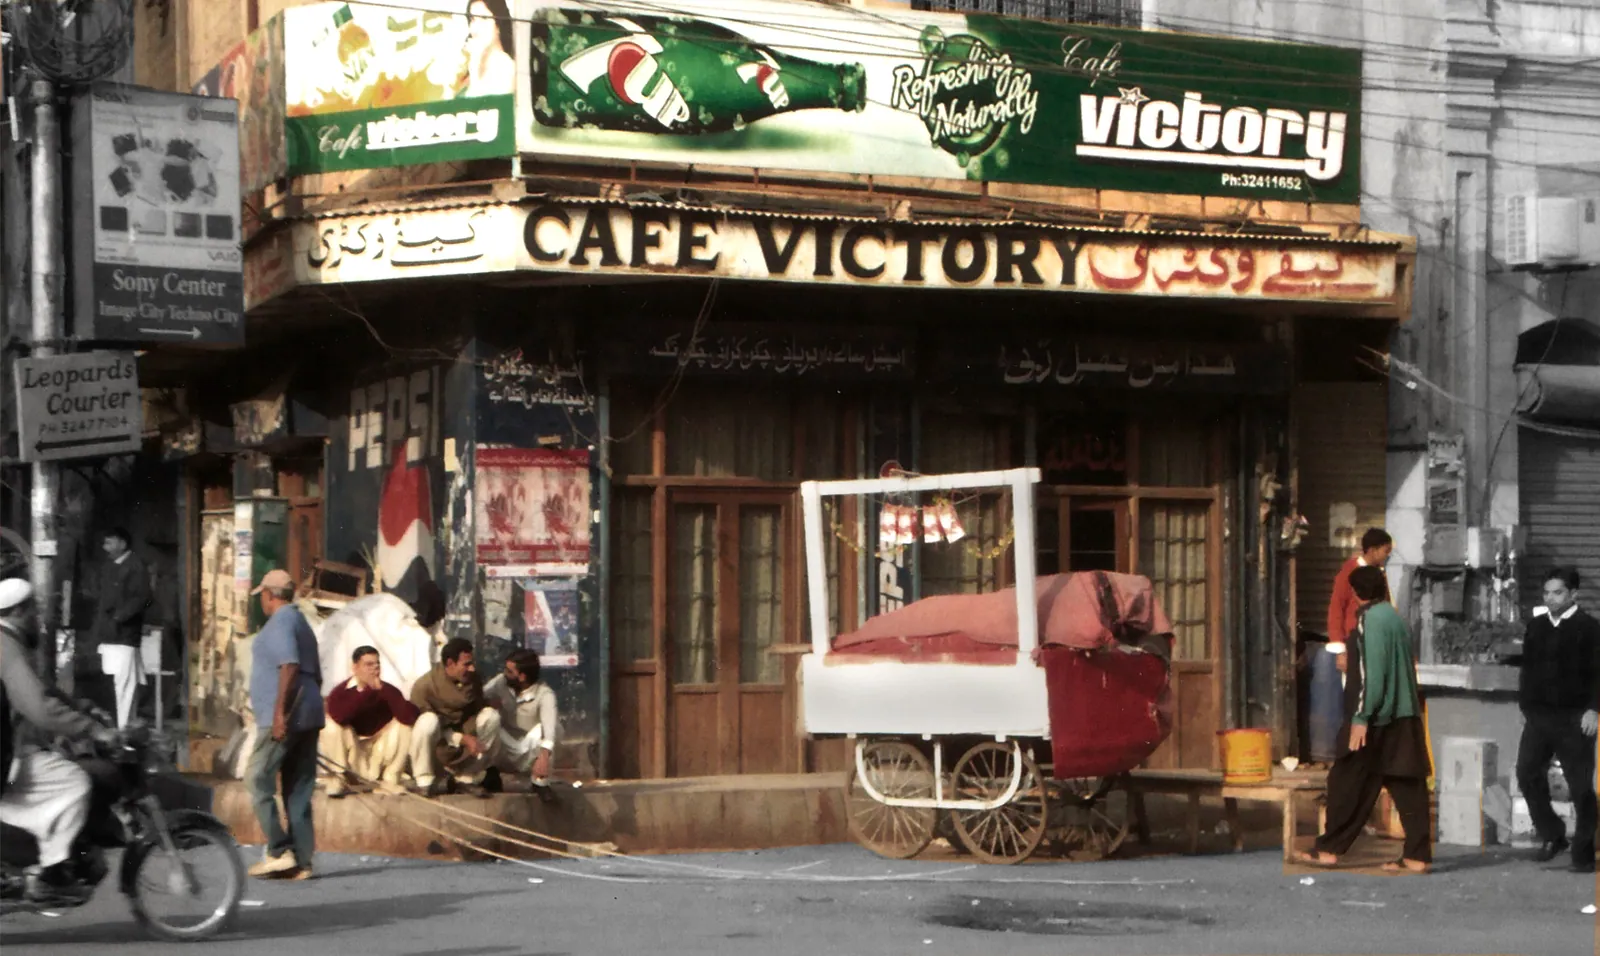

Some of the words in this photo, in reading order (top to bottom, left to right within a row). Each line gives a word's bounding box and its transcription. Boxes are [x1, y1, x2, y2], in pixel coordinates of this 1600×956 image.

[523, 206, 720, 271] CAFE
[753, 216, 1089, 286] VICTORY
[112, 269, 158, 299] Sony
[163, 272, 227, 297] Center
[23, 362, 134, 392] Leopards
[46, 389, 132, 415] Courier
[347, 365, 441, 471] PEPSI
